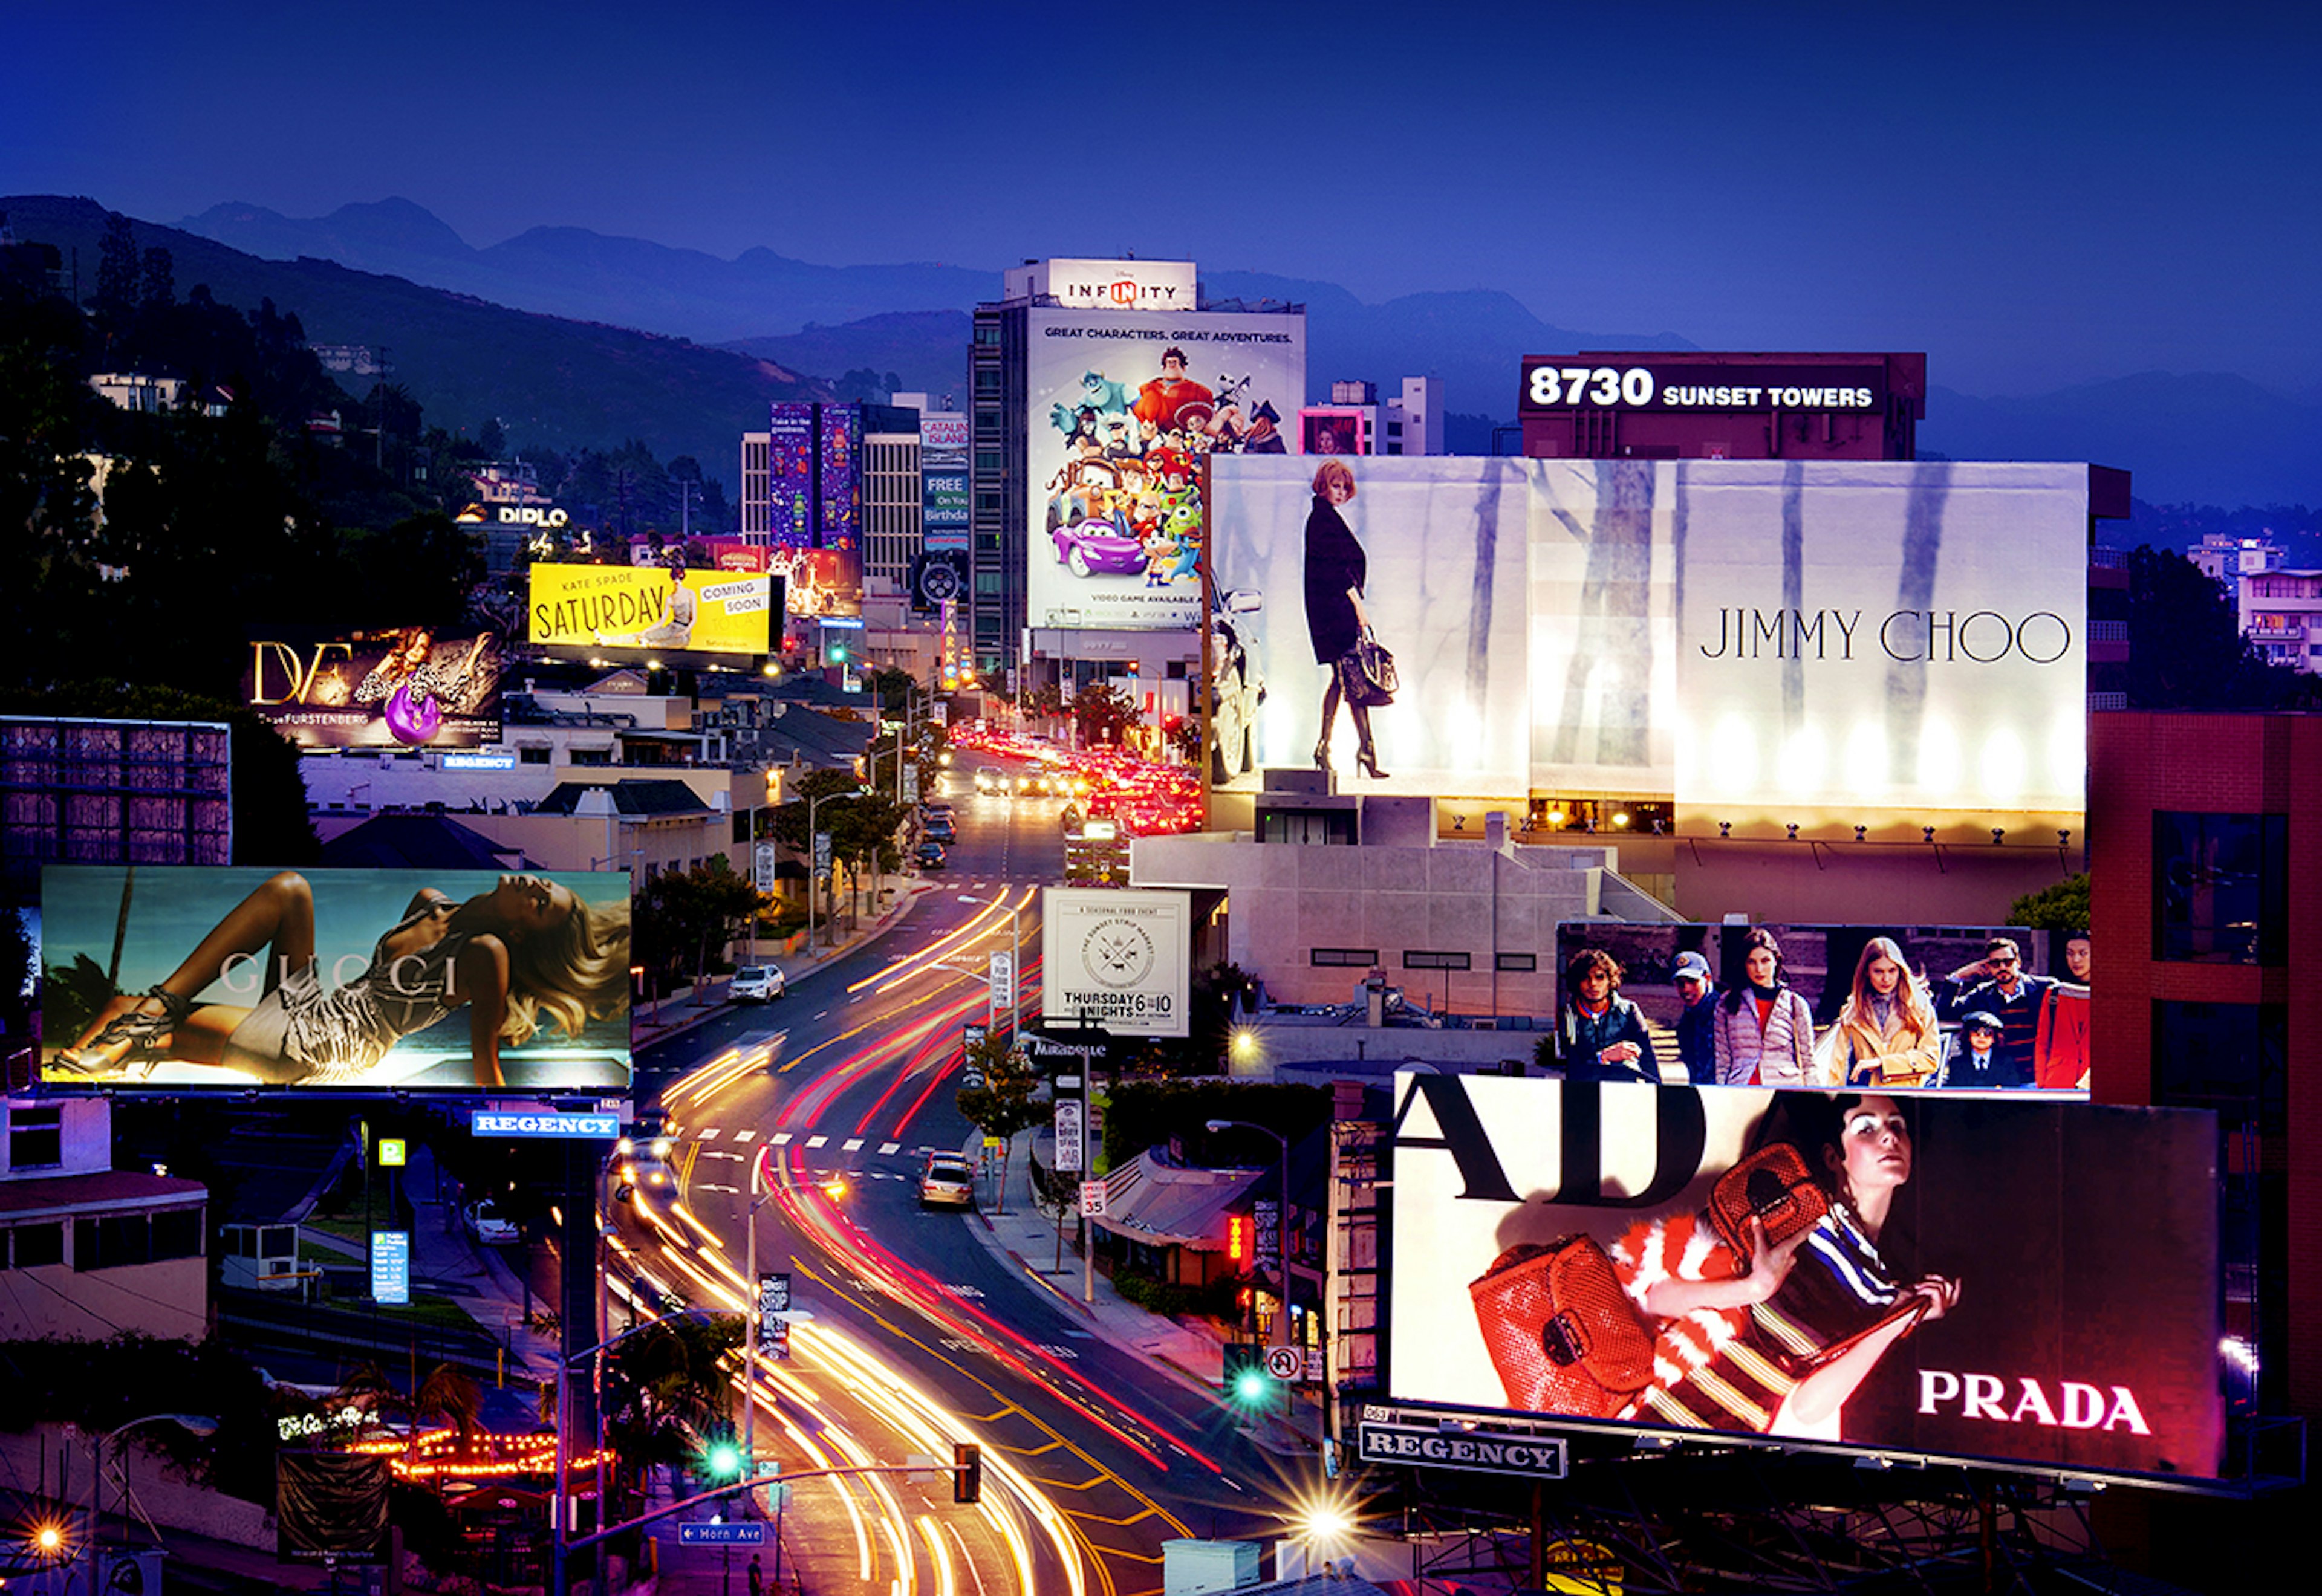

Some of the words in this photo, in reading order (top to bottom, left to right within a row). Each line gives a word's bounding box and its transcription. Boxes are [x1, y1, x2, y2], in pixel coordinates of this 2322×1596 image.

[1068, 281, 1177, 305] INFINITY
[1045, 328, 1084, 337] GREAT
[1171, 331, 1209, 341] GREAT
[1529, 367, 1654, 406] 8730
[1663, 387, 1763, 406] SUNSET
[1768, 388, 1873, 406] TOWERS
[928, 478, 963, 492] FREE
[562, 577, 589, 591] KATE
[596, 572, 633, 586] SPADE
[703, 583, 755, 600] COMING
[536, 586, 664, 638] SATURDAY
[727, 598, 761, 612] SOON
[945, 606, 958, 663] PARK
[1700, 609, 1861, 660] JIMMY
[1880, 611, 2072, 663] CHOO
[284, 713, 369, 725] FURSTENBERG
[220, 952, 457, 996] GUCCI
[1064, 993, 1134, 1004] THURSDAY
[1136, 994, 1145, 1012] 6
[1156, 996, 1171, 1012] 10
[1087, 1006, 1134, 1017] NIGHTS
[477, 1116, 616, 1133] REGENCY
[1085, 1201, 1104, 1213] 35
[1917, 1369, 2153, 1435] PRADA
[1367, 1432, 1555, 1468] REGENCY
[699, 1529, 730, 1539] Horn
[737, 1529, 760, 1540] Ave
